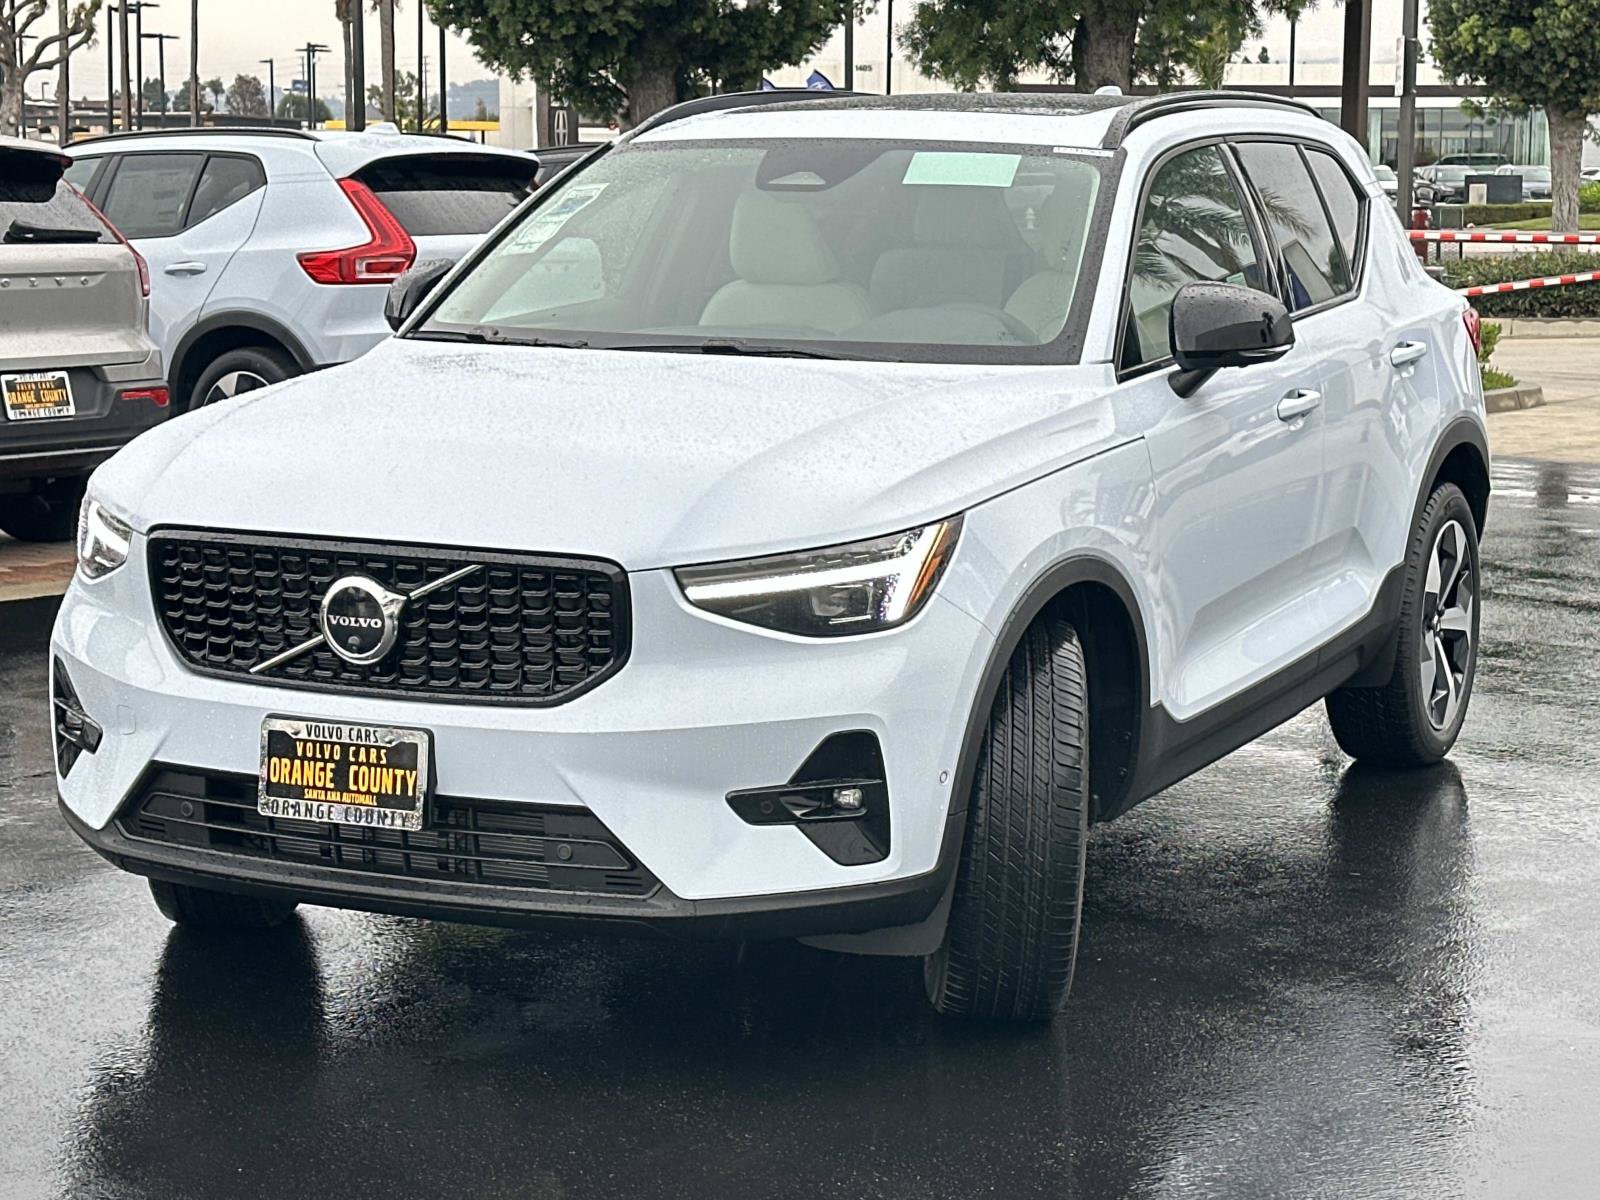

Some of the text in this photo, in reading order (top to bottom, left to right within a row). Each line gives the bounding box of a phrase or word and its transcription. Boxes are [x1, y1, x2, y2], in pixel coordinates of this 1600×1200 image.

[7, 388, 68, 404] ORANGE COUNTY
[327, 614, 382, 629] VOLVO
[305, 724, 379, 744] VOLVO CARS
[296, 741, 387, 764] VOLVO CARS
[269, 757, 417, 797] ORANGE COUNTY
[304, 788, 378, 806] SANTA ANA AUTOMALL
[270, 799, 409, 828] ORANGE COUNTY
